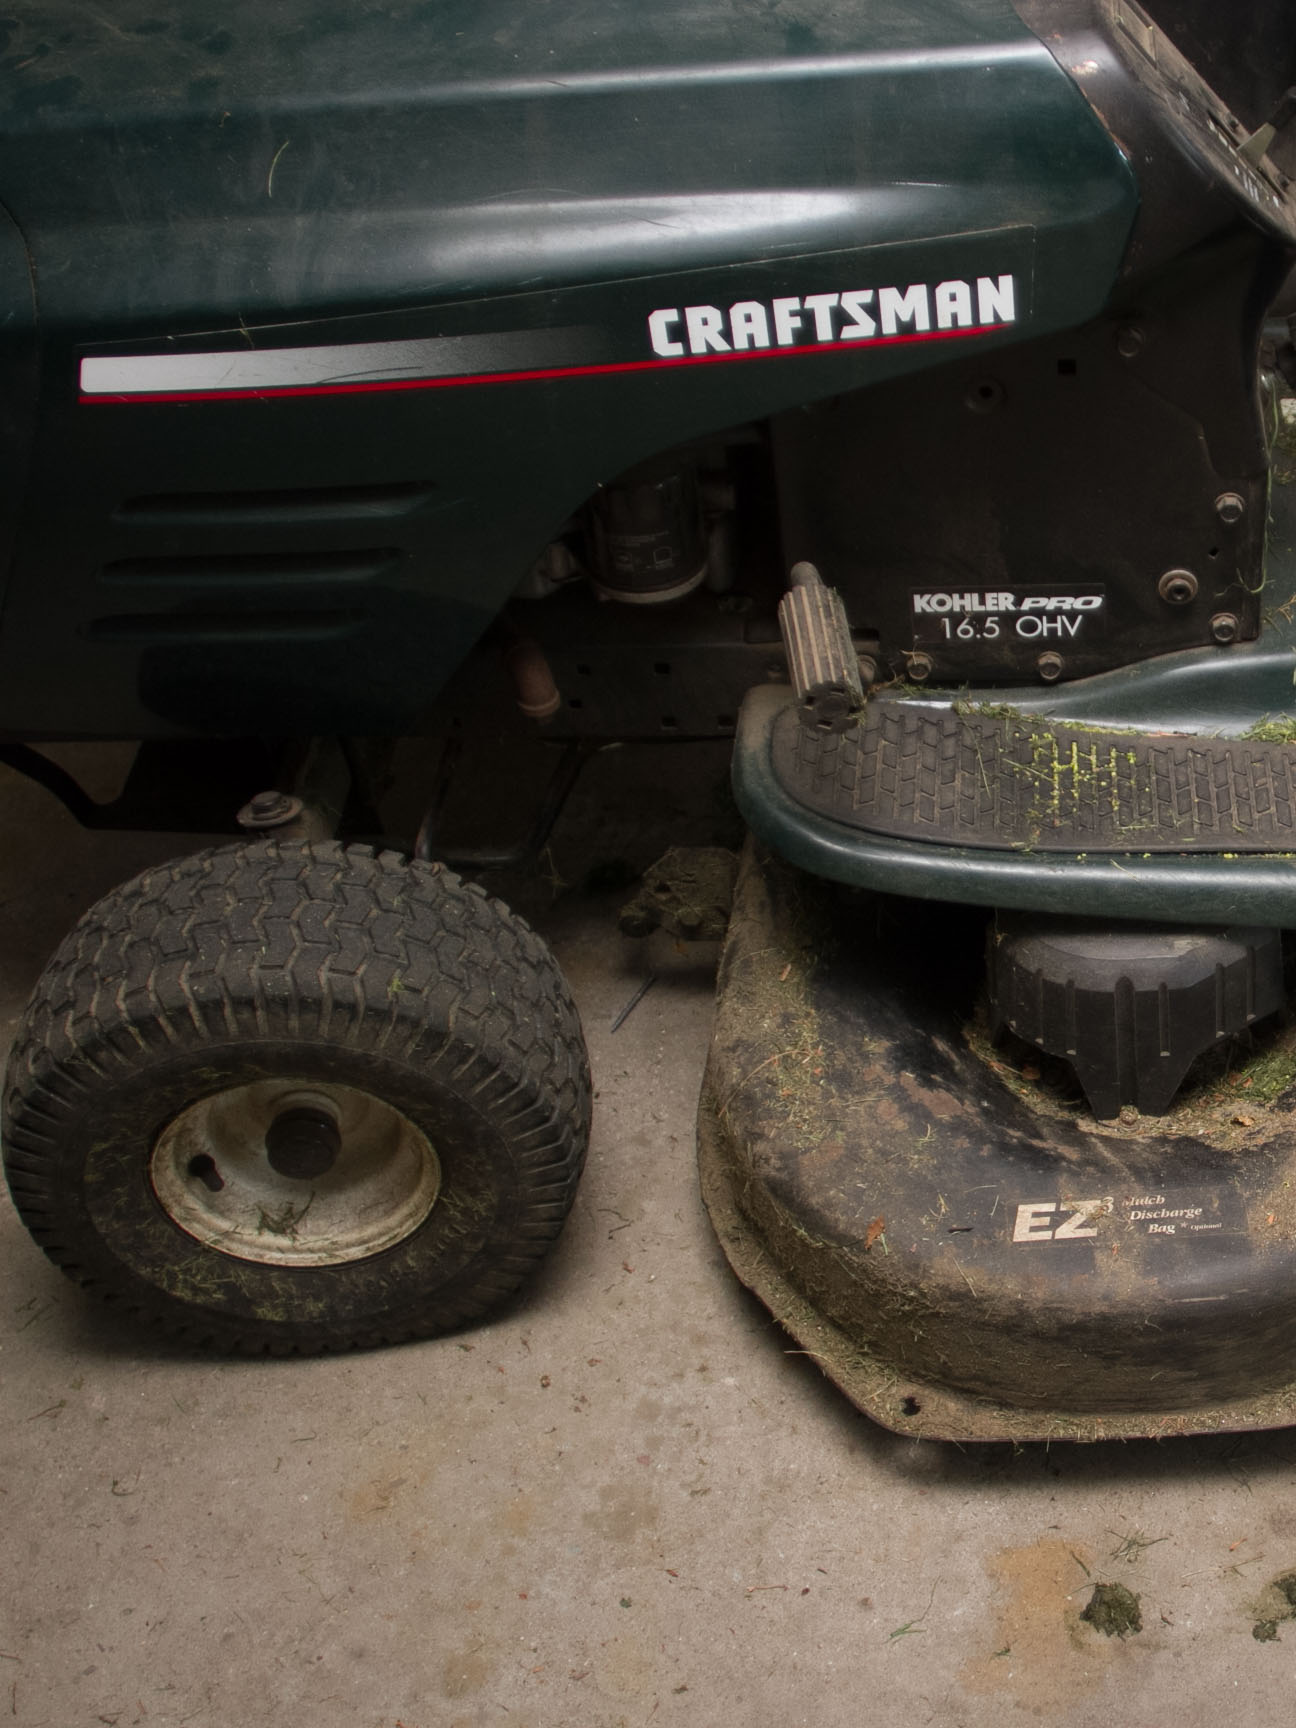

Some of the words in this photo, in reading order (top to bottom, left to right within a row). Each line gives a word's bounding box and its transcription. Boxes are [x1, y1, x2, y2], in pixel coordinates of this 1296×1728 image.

[648, 274, 1015, 357] CRAFTSMAN
[913, 592, 1016, 612] KOHLER
[1020, 596, 1102, 610] PRO
[942, 616, 1000, 639] 16.5
[1015, 615, 1083, 637] OHV
[1130, 1207, 1203, 1220] Discharge
[1147, 1223, 1176, 1235] Bag
